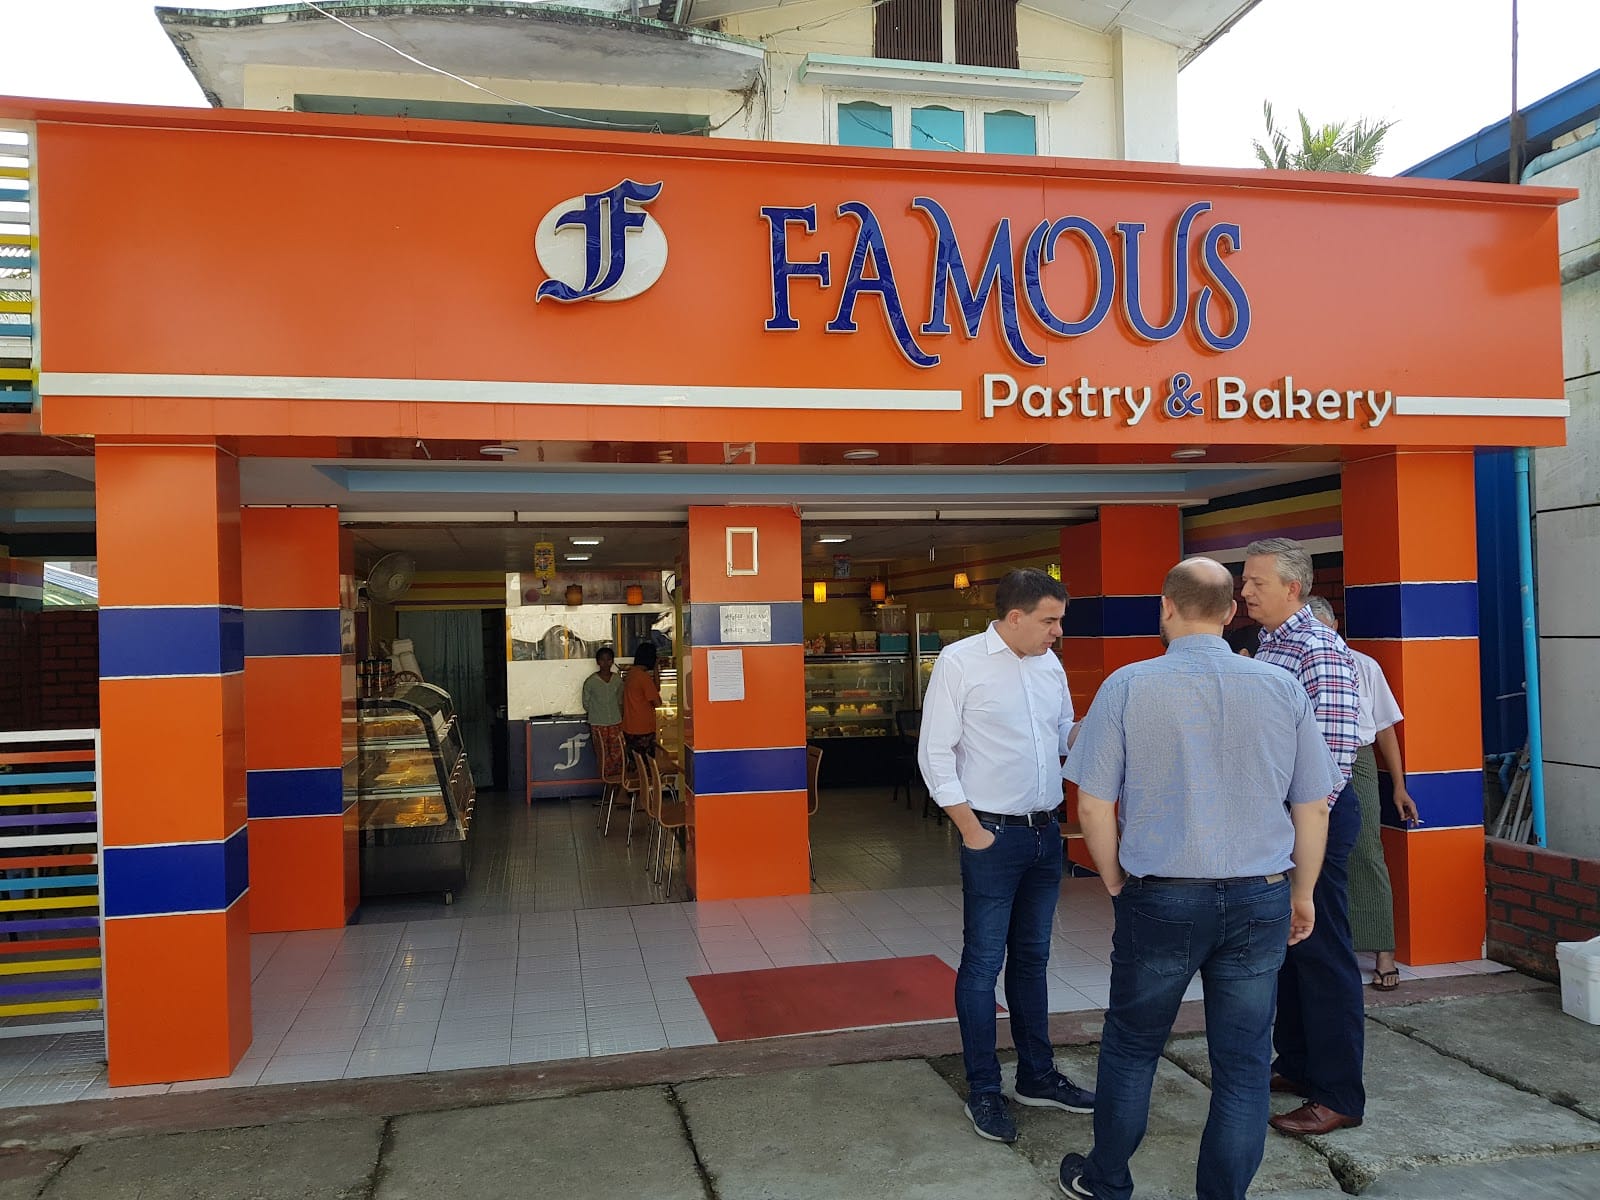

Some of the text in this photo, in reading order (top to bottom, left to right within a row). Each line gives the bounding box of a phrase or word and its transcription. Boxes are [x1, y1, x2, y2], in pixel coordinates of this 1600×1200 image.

[758, 195, 1253, 369] FAMOUS
[981, 371, 1395, 429] Pastry & Bakery
